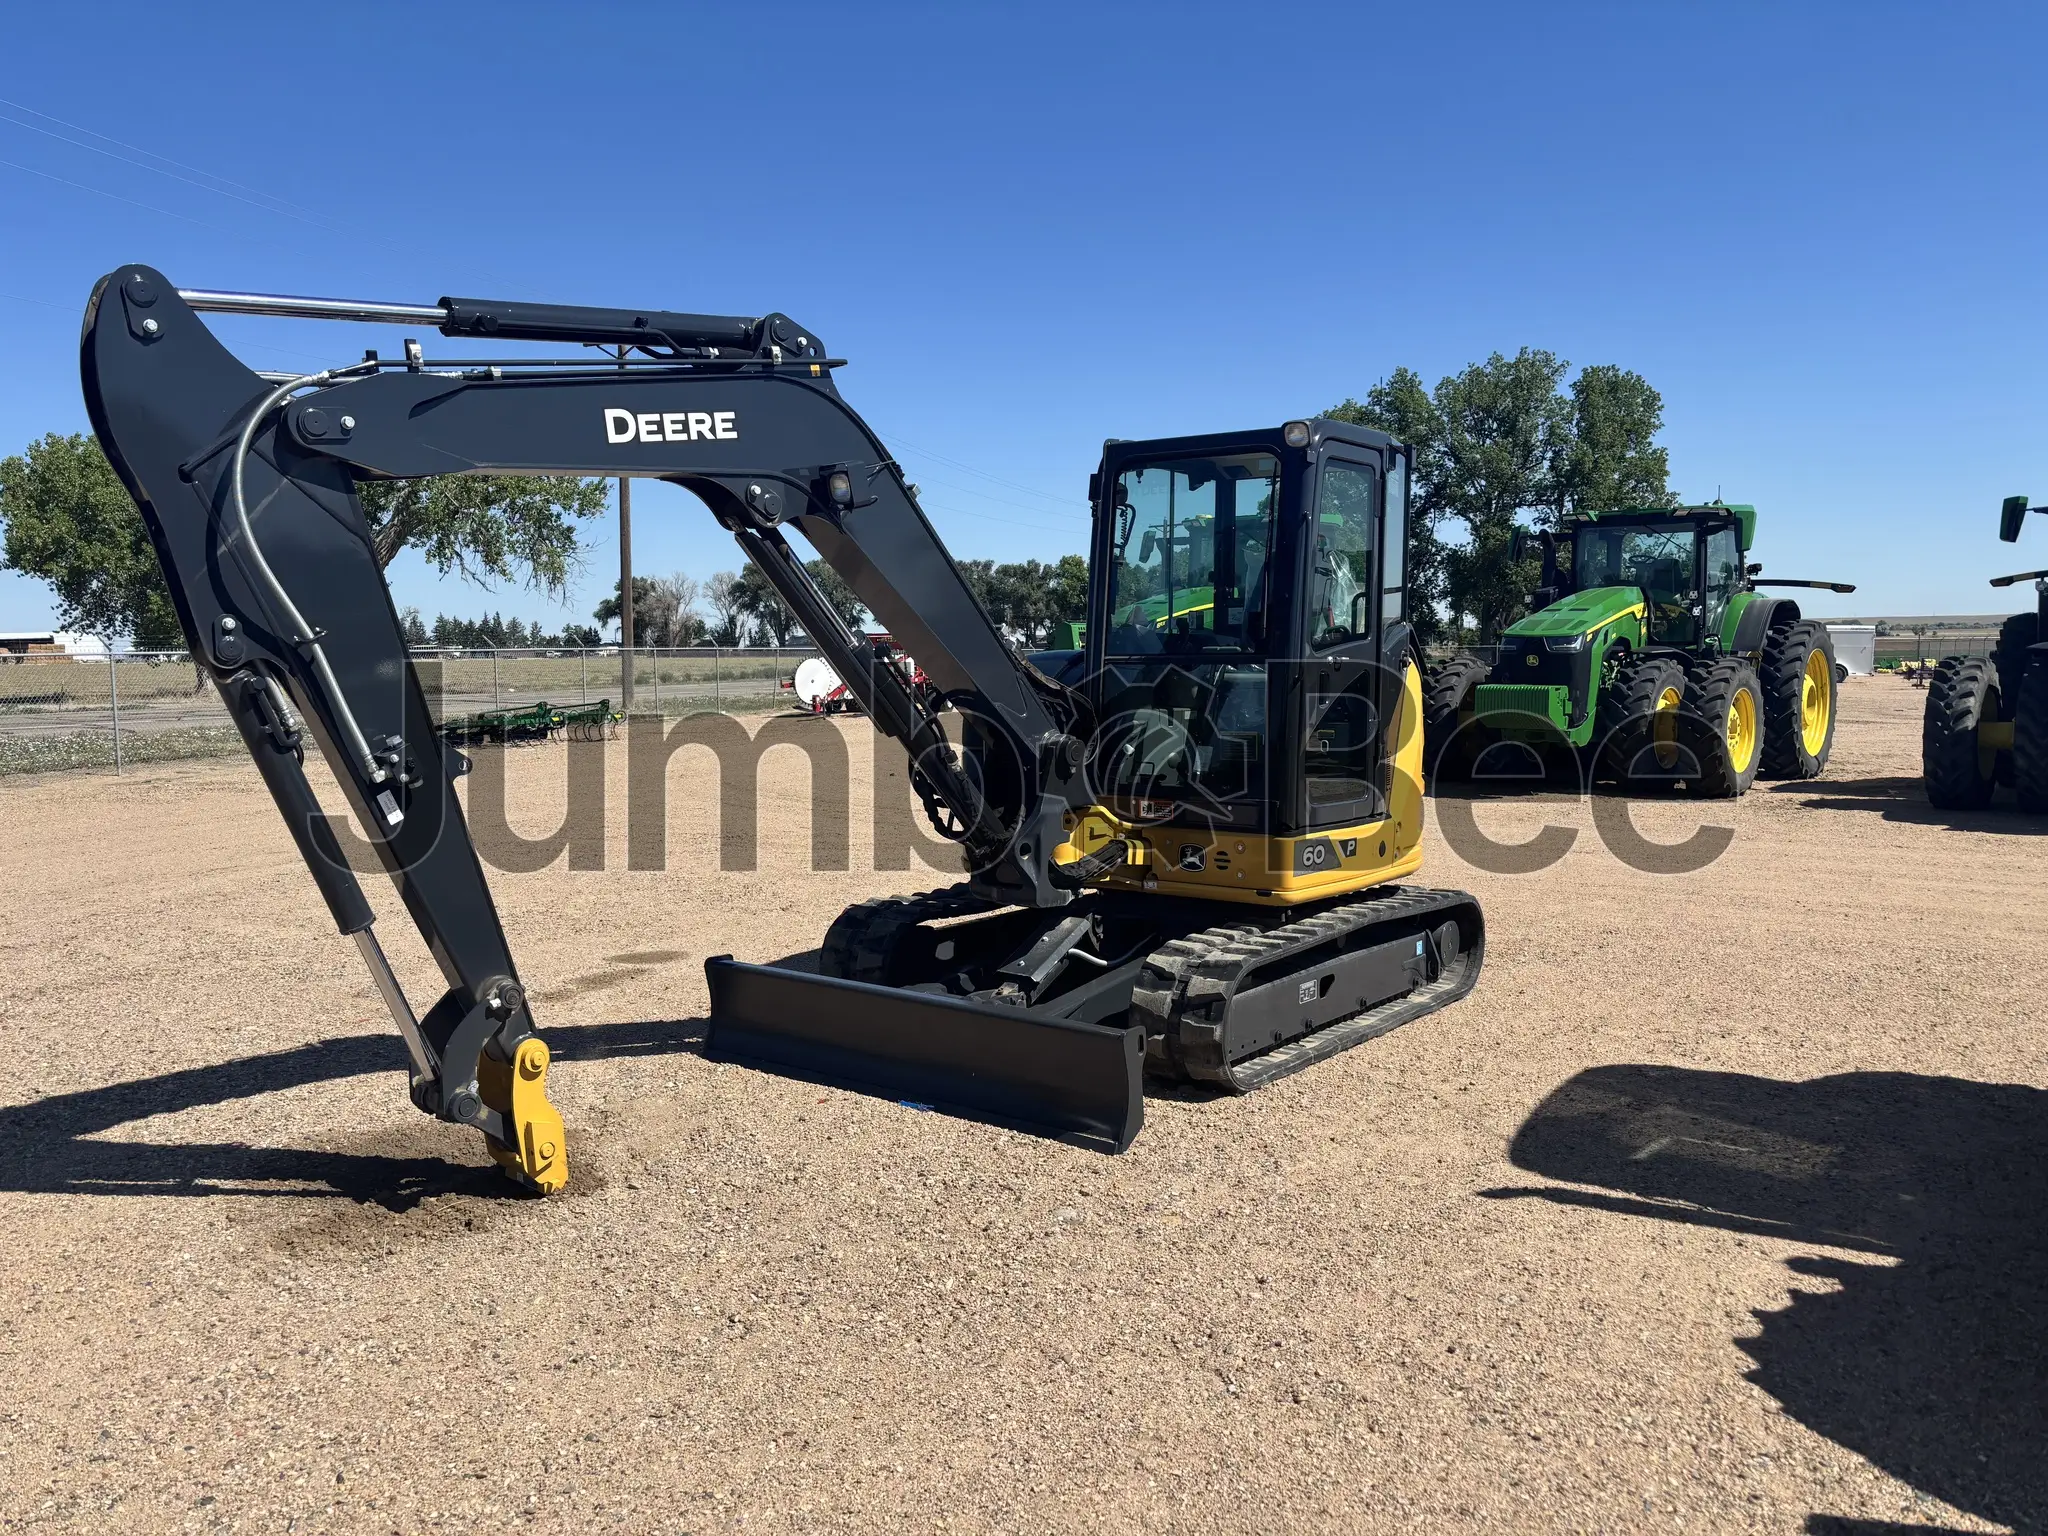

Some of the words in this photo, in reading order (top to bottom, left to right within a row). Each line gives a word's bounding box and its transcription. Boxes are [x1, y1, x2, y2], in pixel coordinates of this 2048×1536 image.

[603, 408, 739, 444] DEERE
[1302, 844, 1325, 868] 60
[1346, 840, 1356, 856] P
